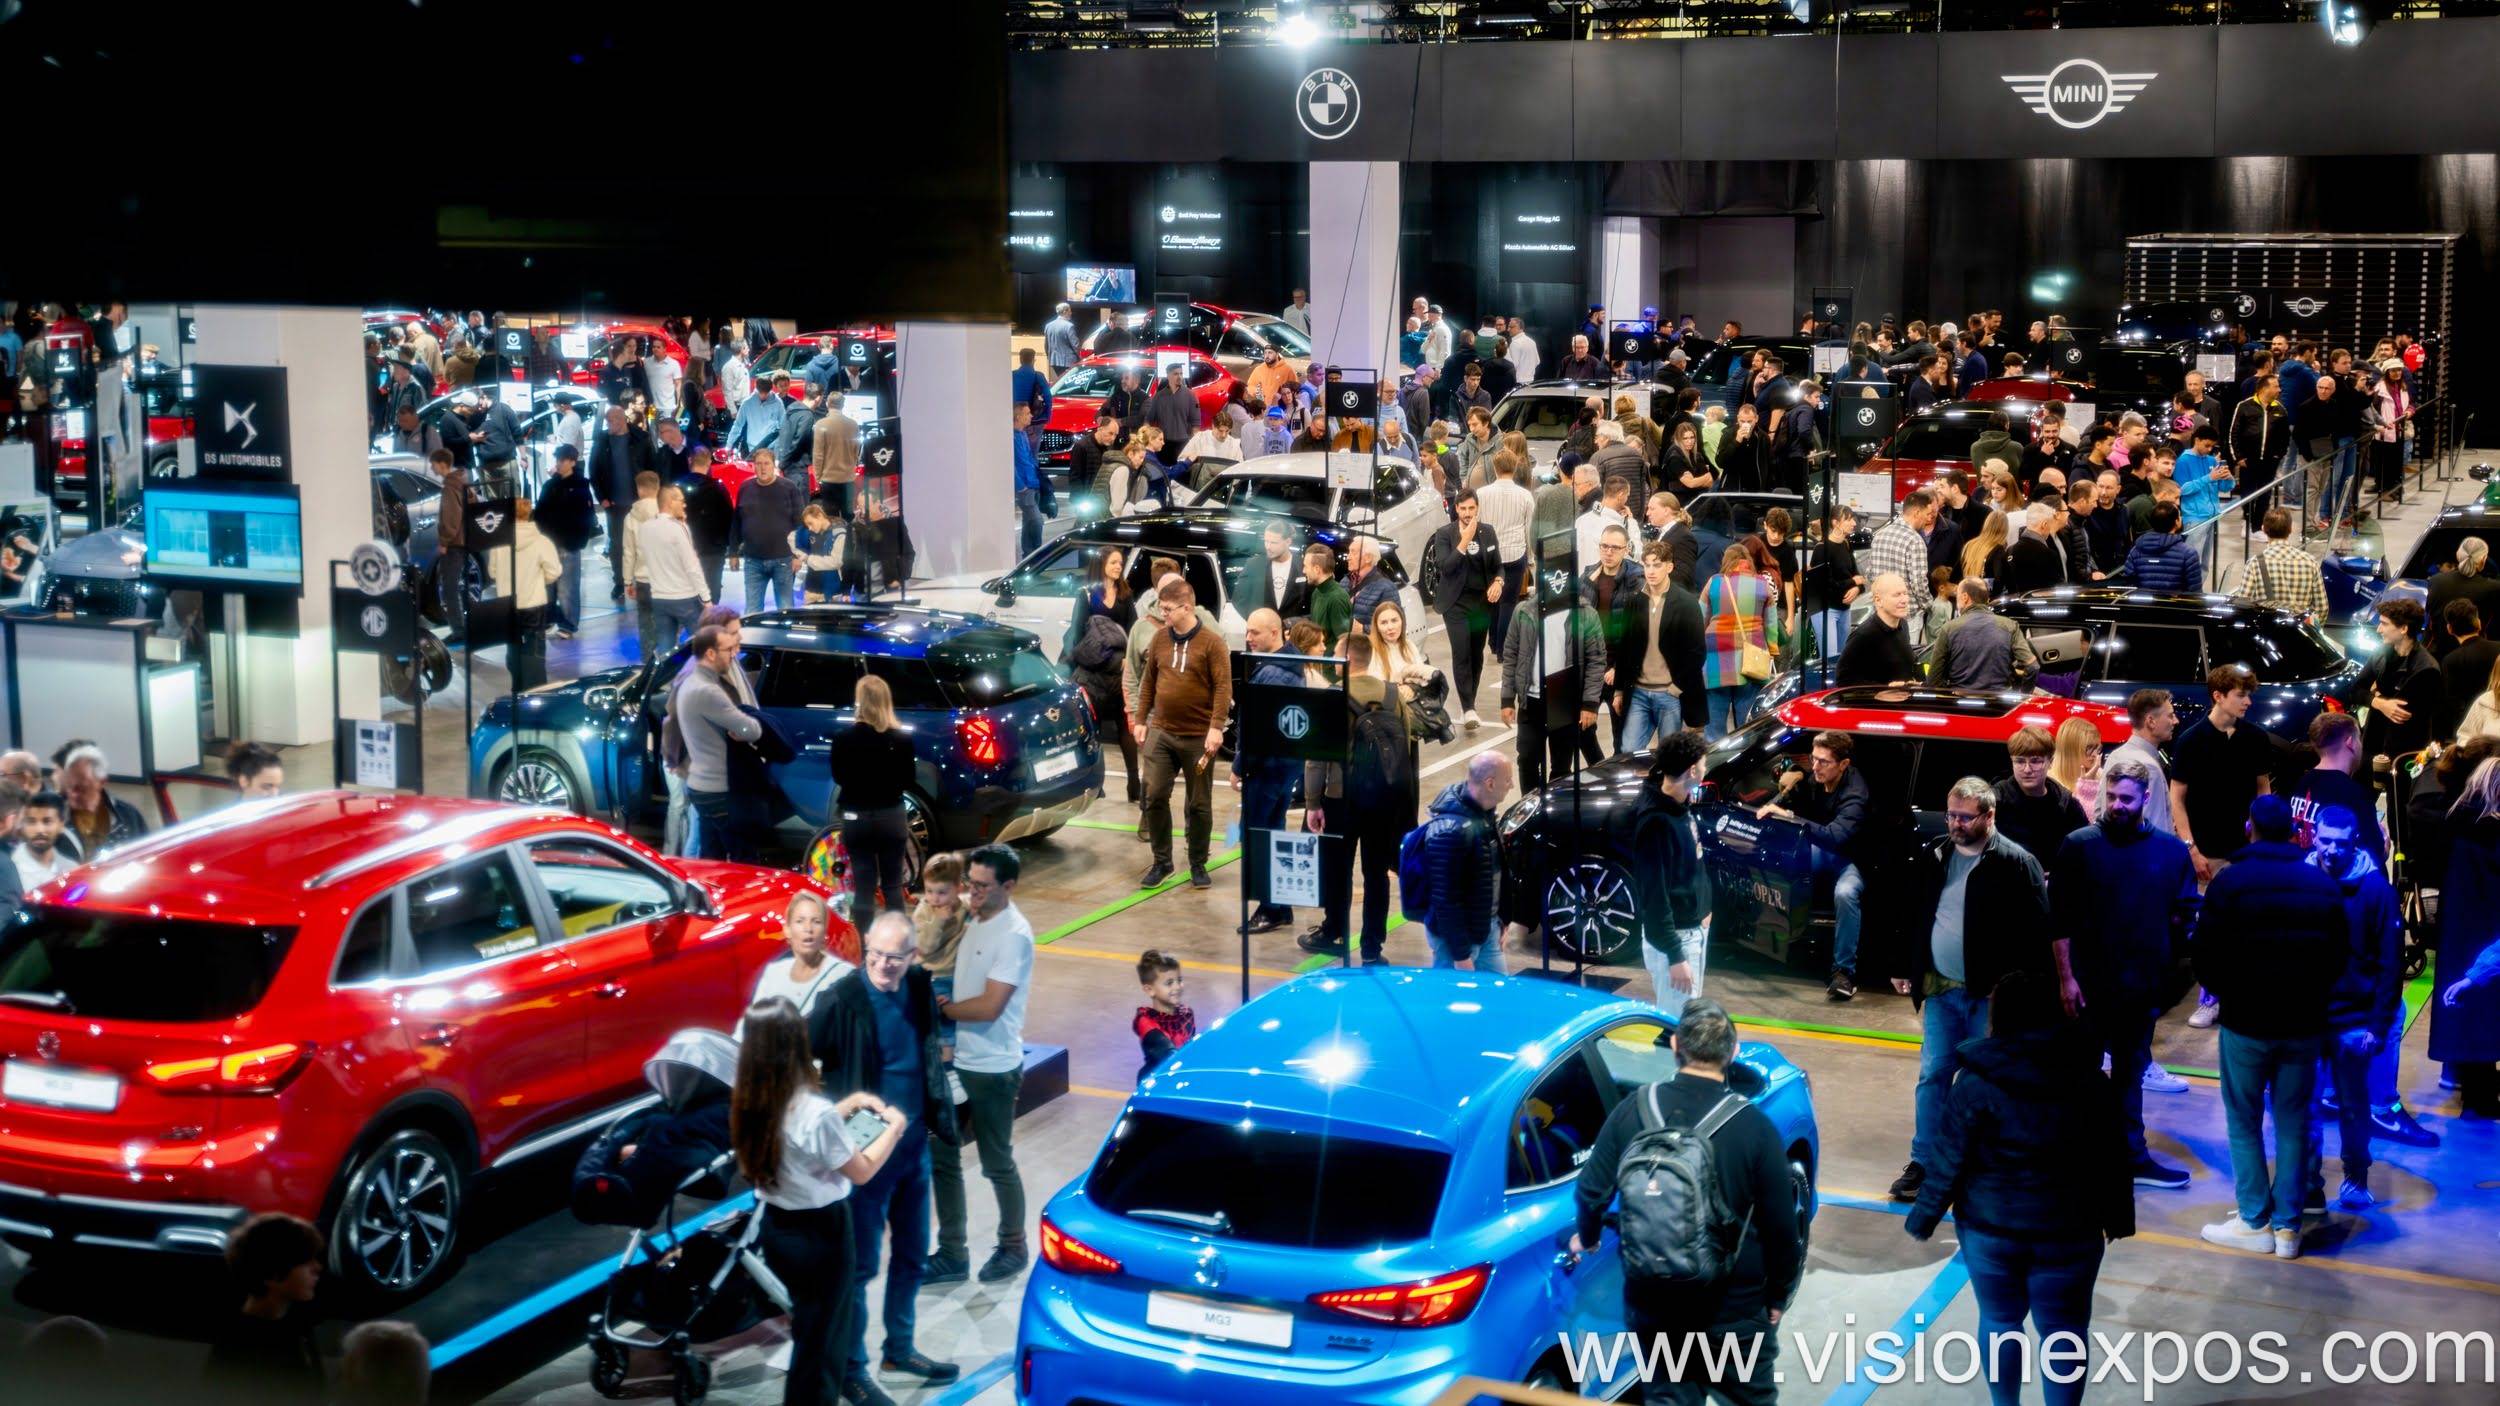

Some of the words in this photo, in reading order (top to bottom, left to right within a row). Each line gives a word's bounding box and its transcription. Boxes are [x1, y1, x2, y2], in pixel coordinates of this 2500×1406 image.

[1305, 72, 1351, 92] BMW
[2053, 85, 2103, 103] MINI
[204, 452, 217, 465] DS
[219, 453, 282, 468] AUTOMOBILES
[362, 607, 385, 636] MG
[1281, 707, 1307, 737] MG
[1204, 1311, 1232, 1327] MG3
